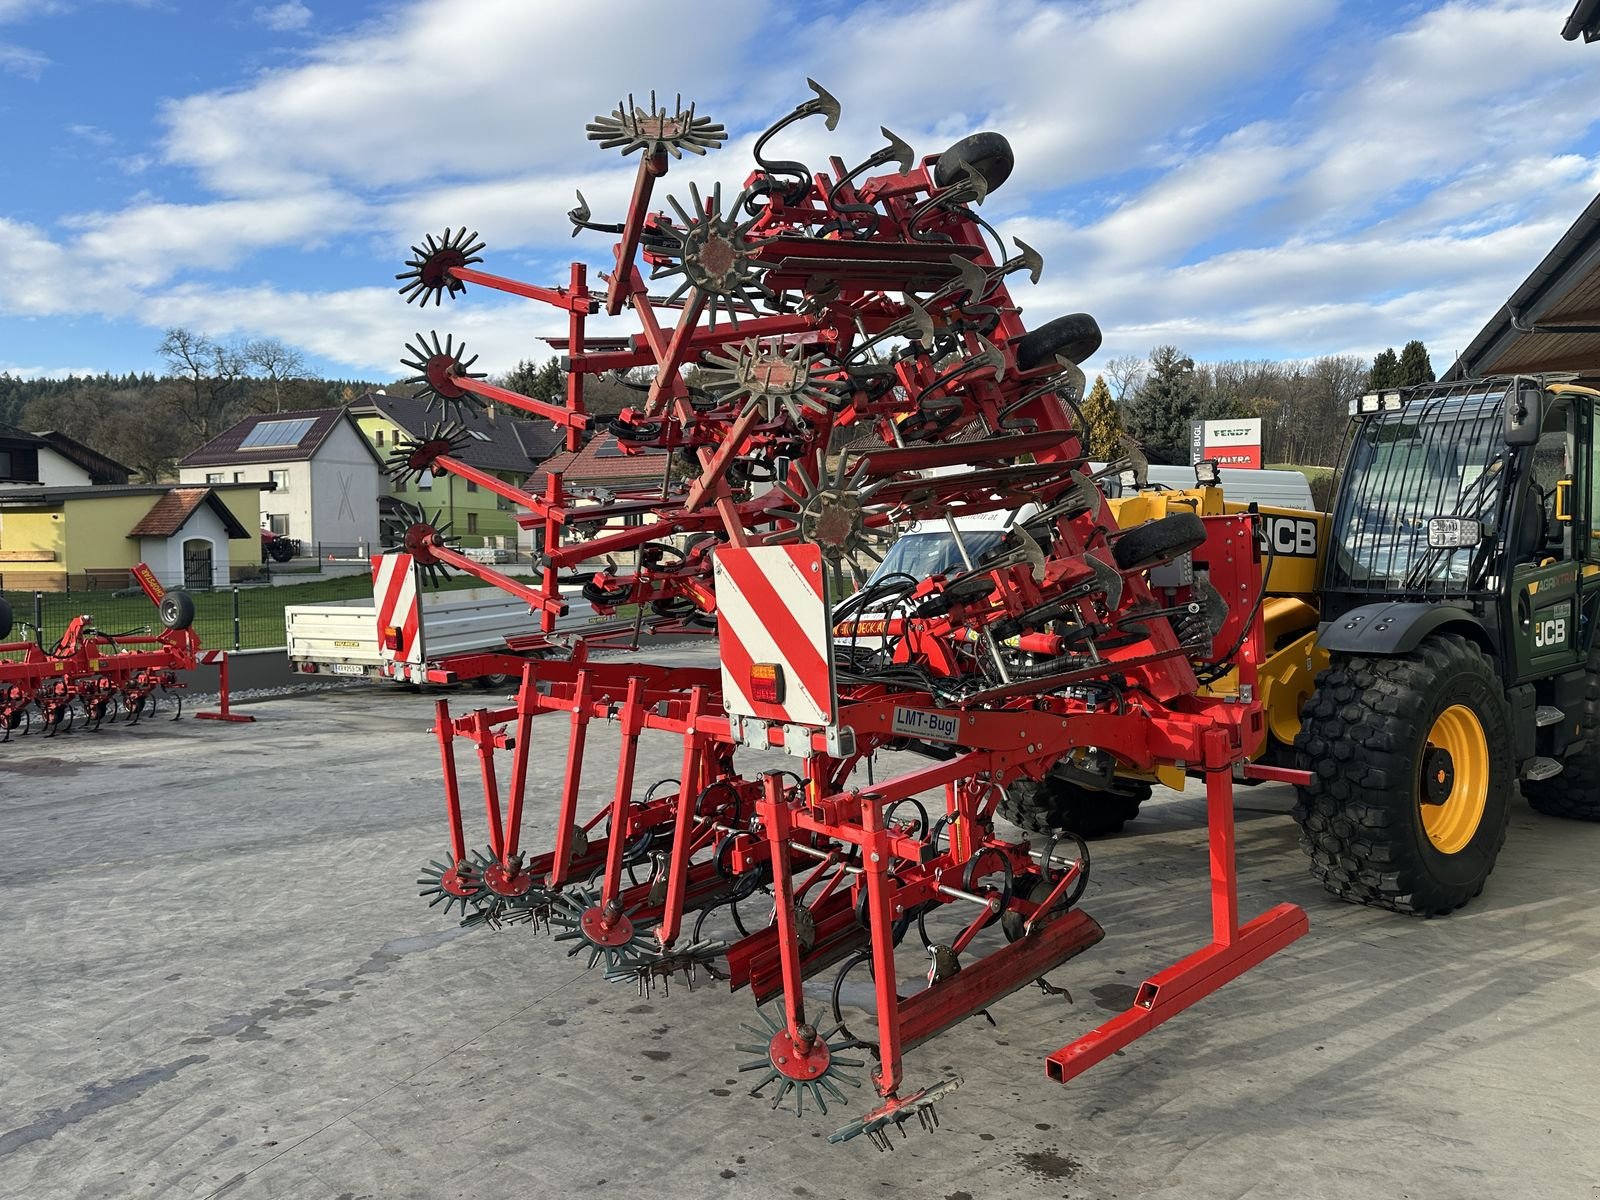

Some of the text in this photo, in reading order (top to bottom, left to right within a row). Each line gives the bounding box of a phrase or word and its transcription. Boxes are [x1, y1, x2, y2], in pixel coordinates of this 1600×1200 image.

[1193, 425, 1202, 447] BUGL
[1213, 428, 1252, 437] FENDT
[1260, 517, 1316, 555] JCB
[141, 568, 165, 598] CHOPSTAR
[1535, 618, 1566, 648] JCB
[897, 708, 957, 736] LMT-Bugl
